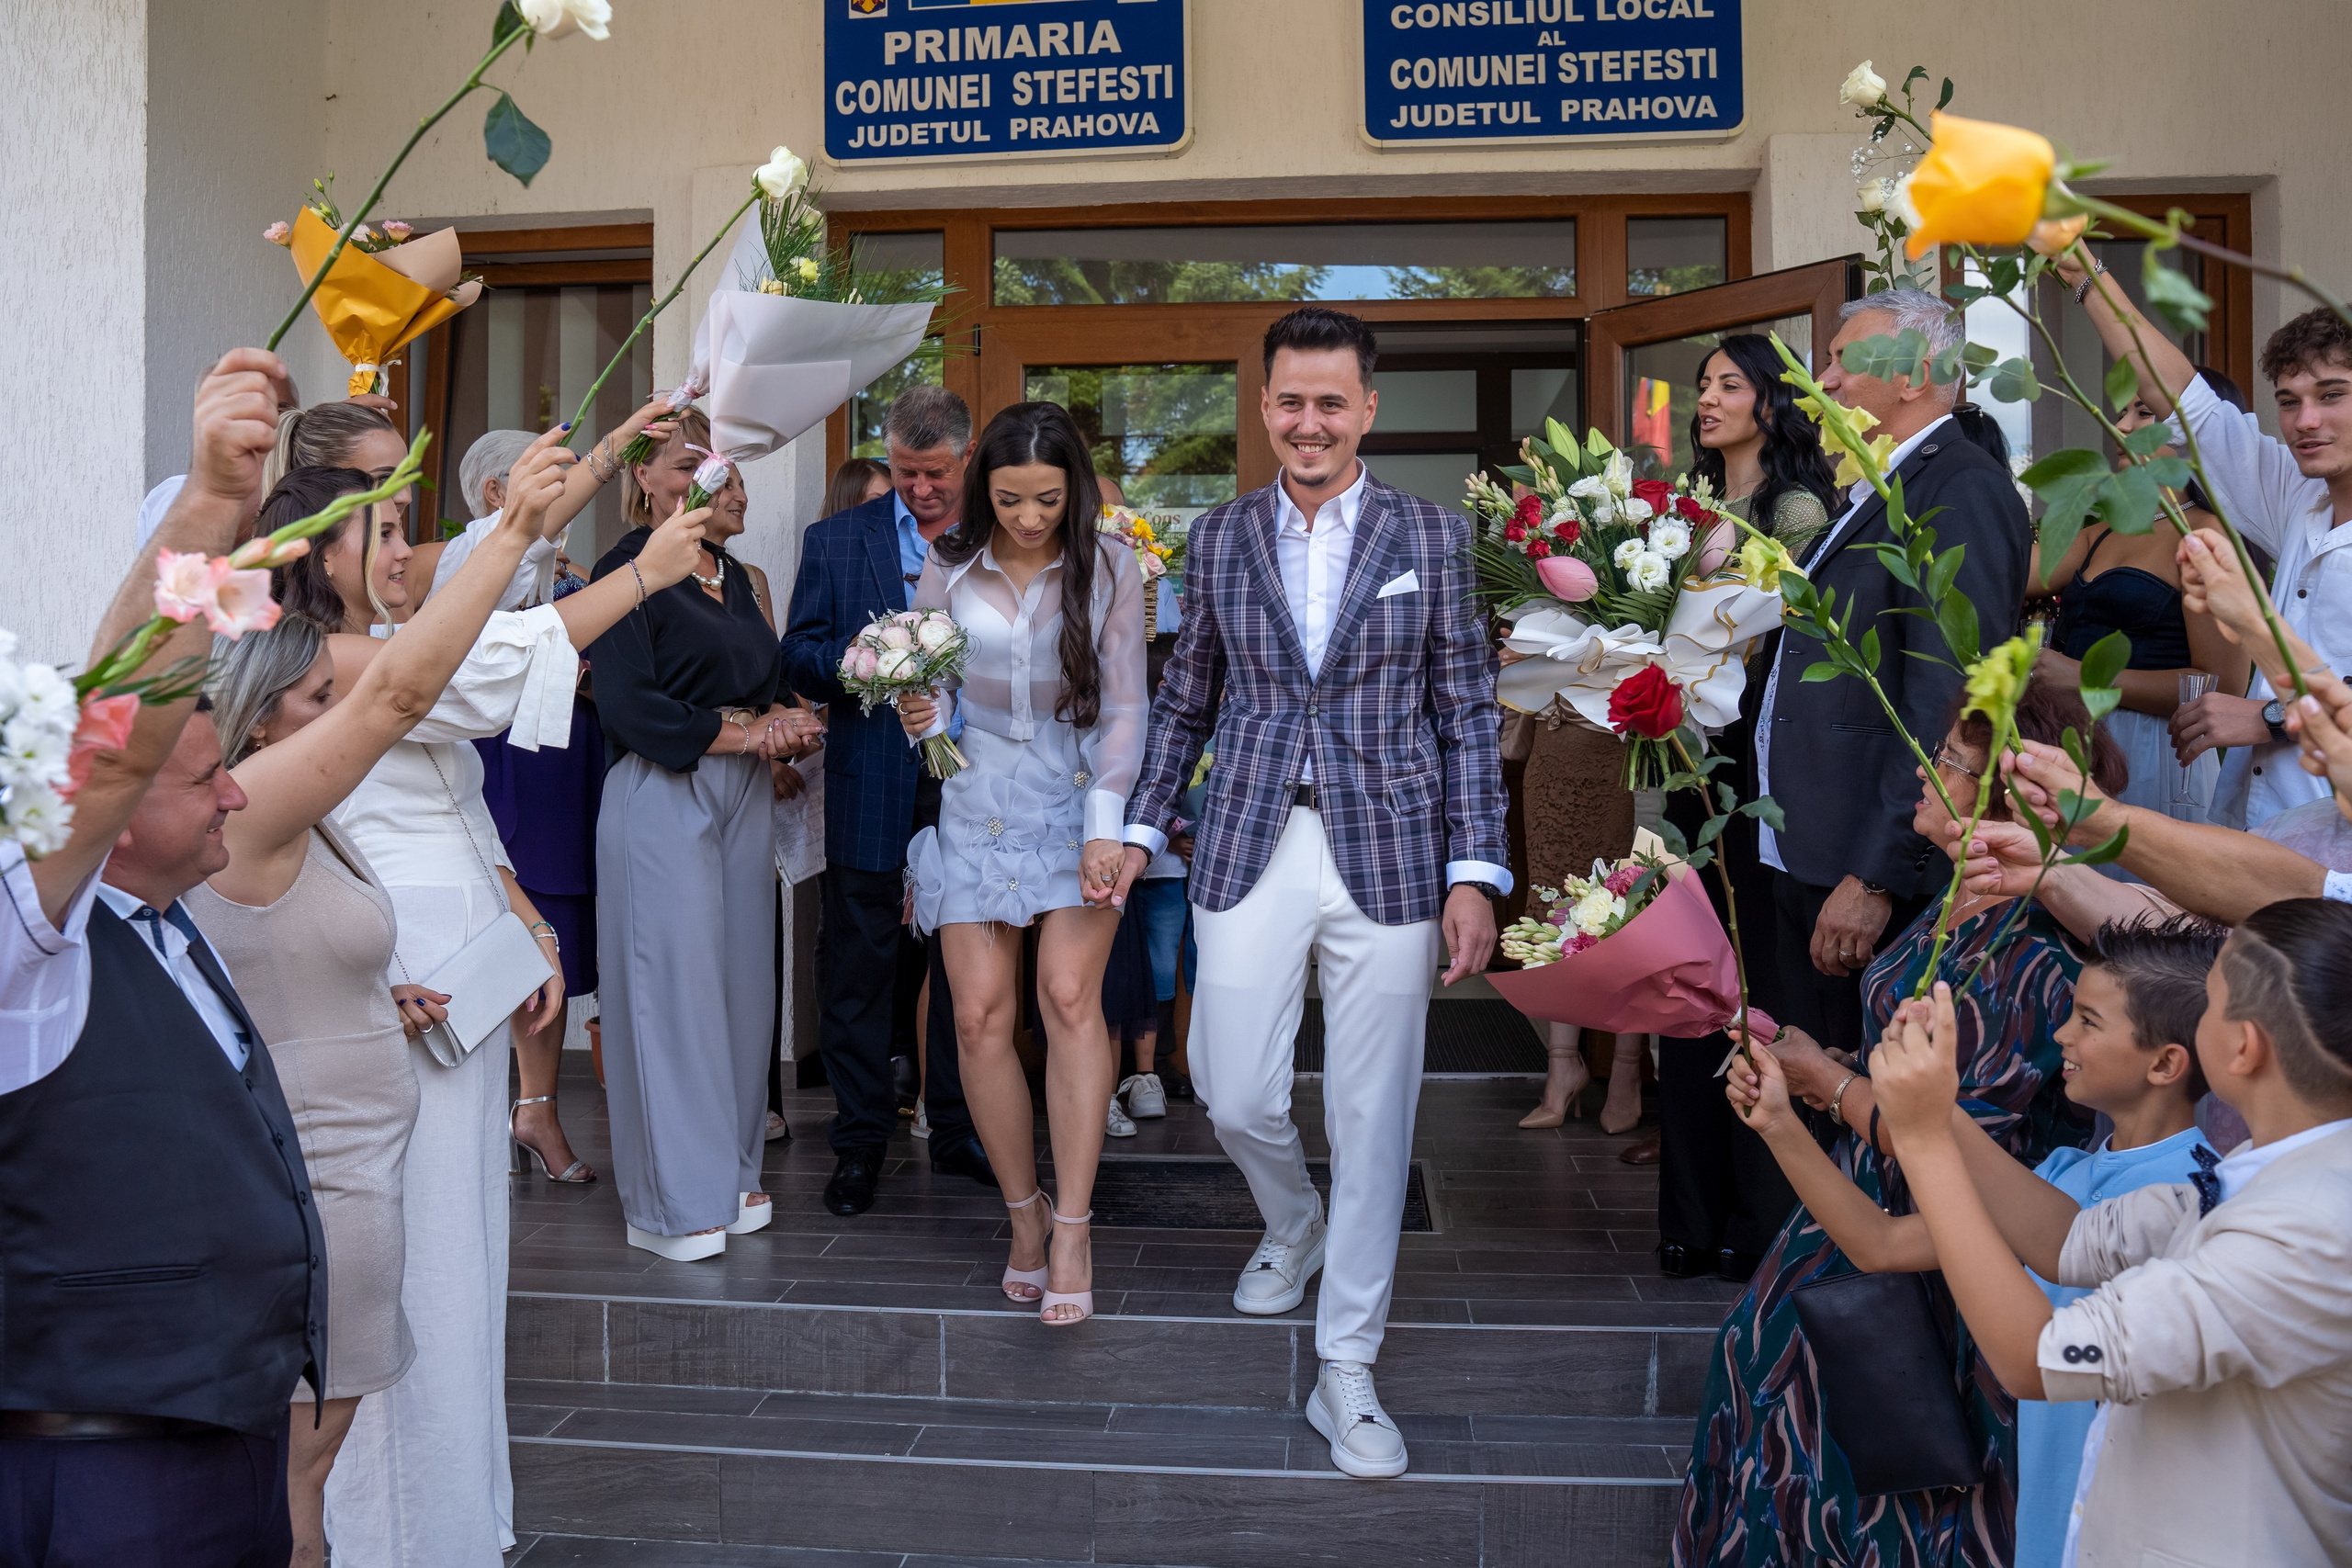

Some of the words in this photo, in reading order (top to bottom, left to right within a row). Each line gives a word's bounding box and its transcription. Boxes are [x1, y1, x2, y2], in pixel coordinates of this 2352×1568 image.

[1390, 0, 1584, 29] CONSILIUL
[1596, 0, 1714, 21] LOCAL
[884, 19, 1123, 66] PRIMARIA
[1537, 30, 1566, 47] AL
[1390, 53, 1546, 90] COMUNEI
[1557, 48, 1717, 84] STEFESTI
[835, 73, 990, 116] COMUNEI
[1012, 64, 1173, 107] STEFESTI
[848, 120, 990, 149] JUDETUL
[1010, 112, 1160, 141] PRAHOVA
[1389, 101, 1541, 129] JUDETUL
[1561, 96, 1718, 122] PRAHOVA
